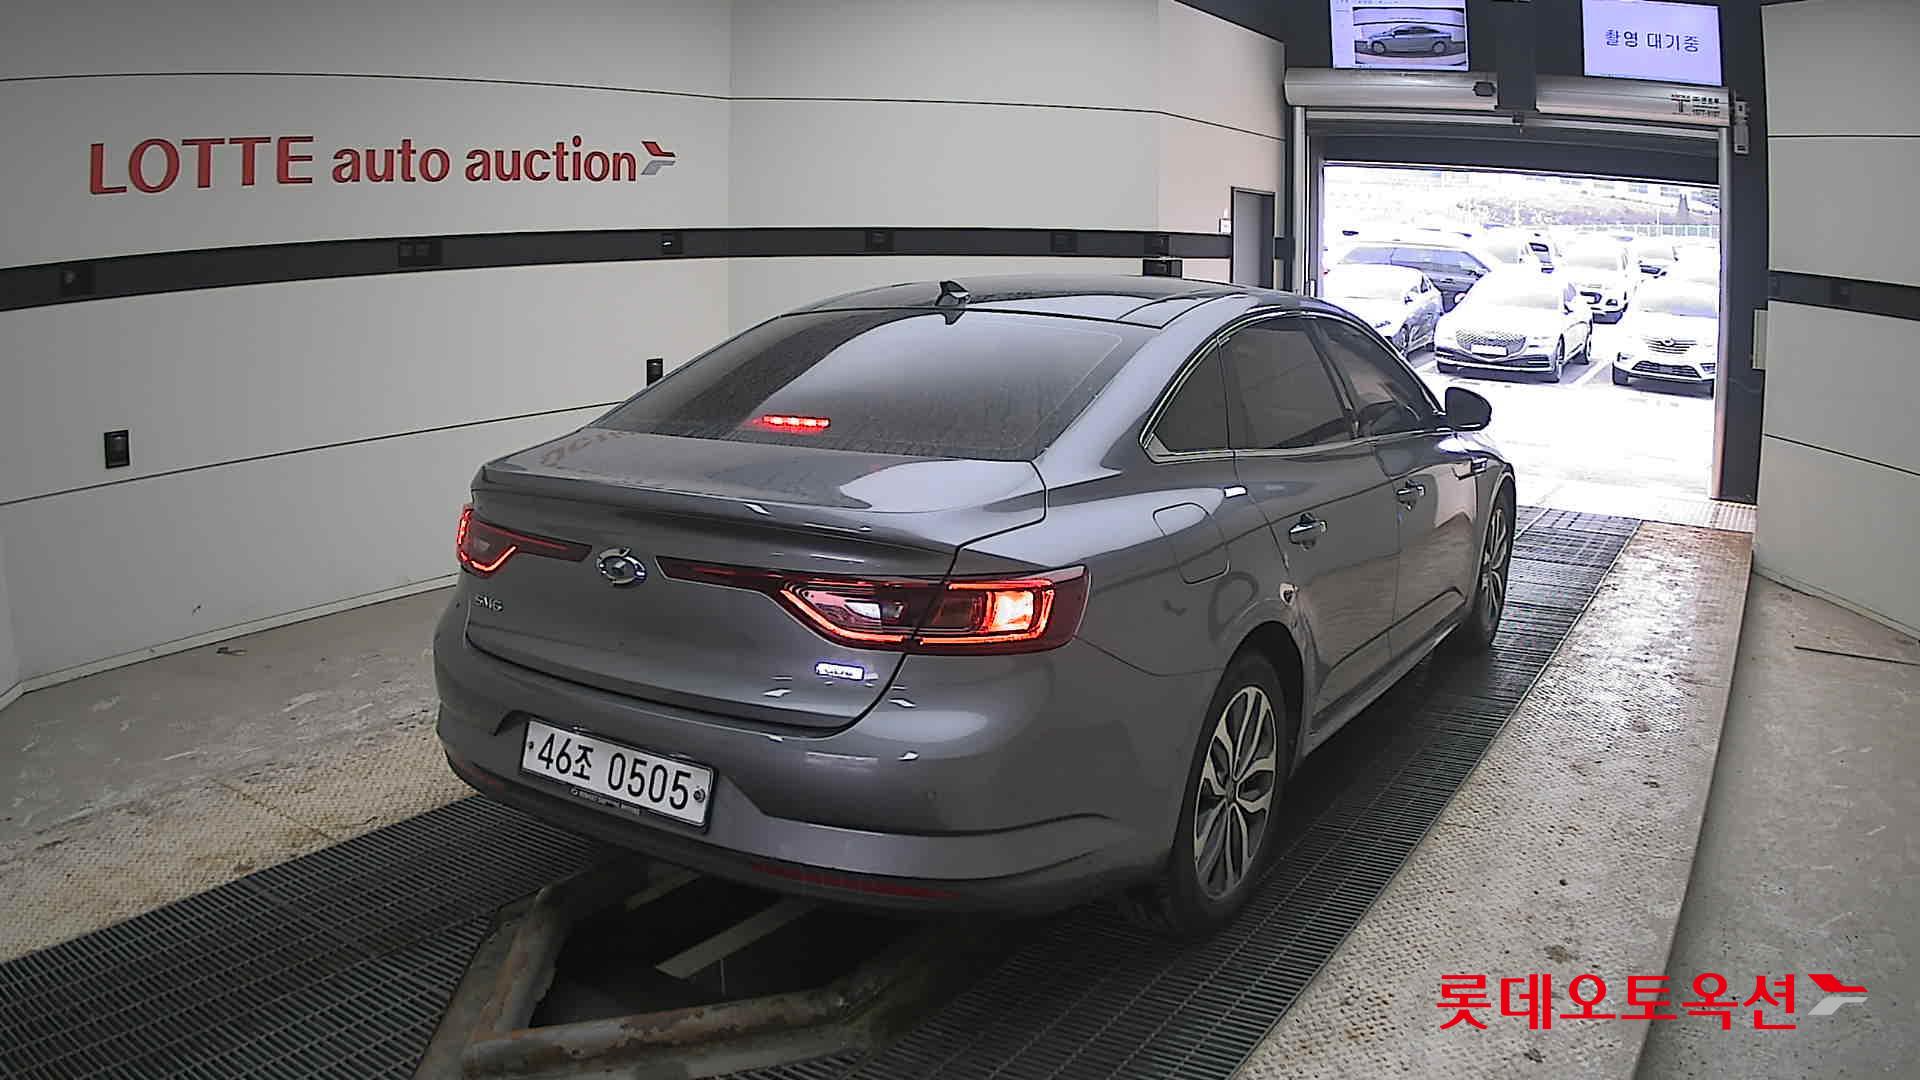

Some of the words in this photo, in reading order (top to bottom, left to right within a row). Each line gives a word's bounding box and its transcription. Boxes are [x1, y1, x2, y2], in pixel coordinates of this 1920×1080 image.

[1647, 32, 1699, 53] 대기중
[90, 135, 314, 195] LOTTE
[332, 138, 449, 184] auto
[465, 135, 637, 183] auction
[537, 733, 594, 781] 46조
[607, 752, 693, 811] 0505
